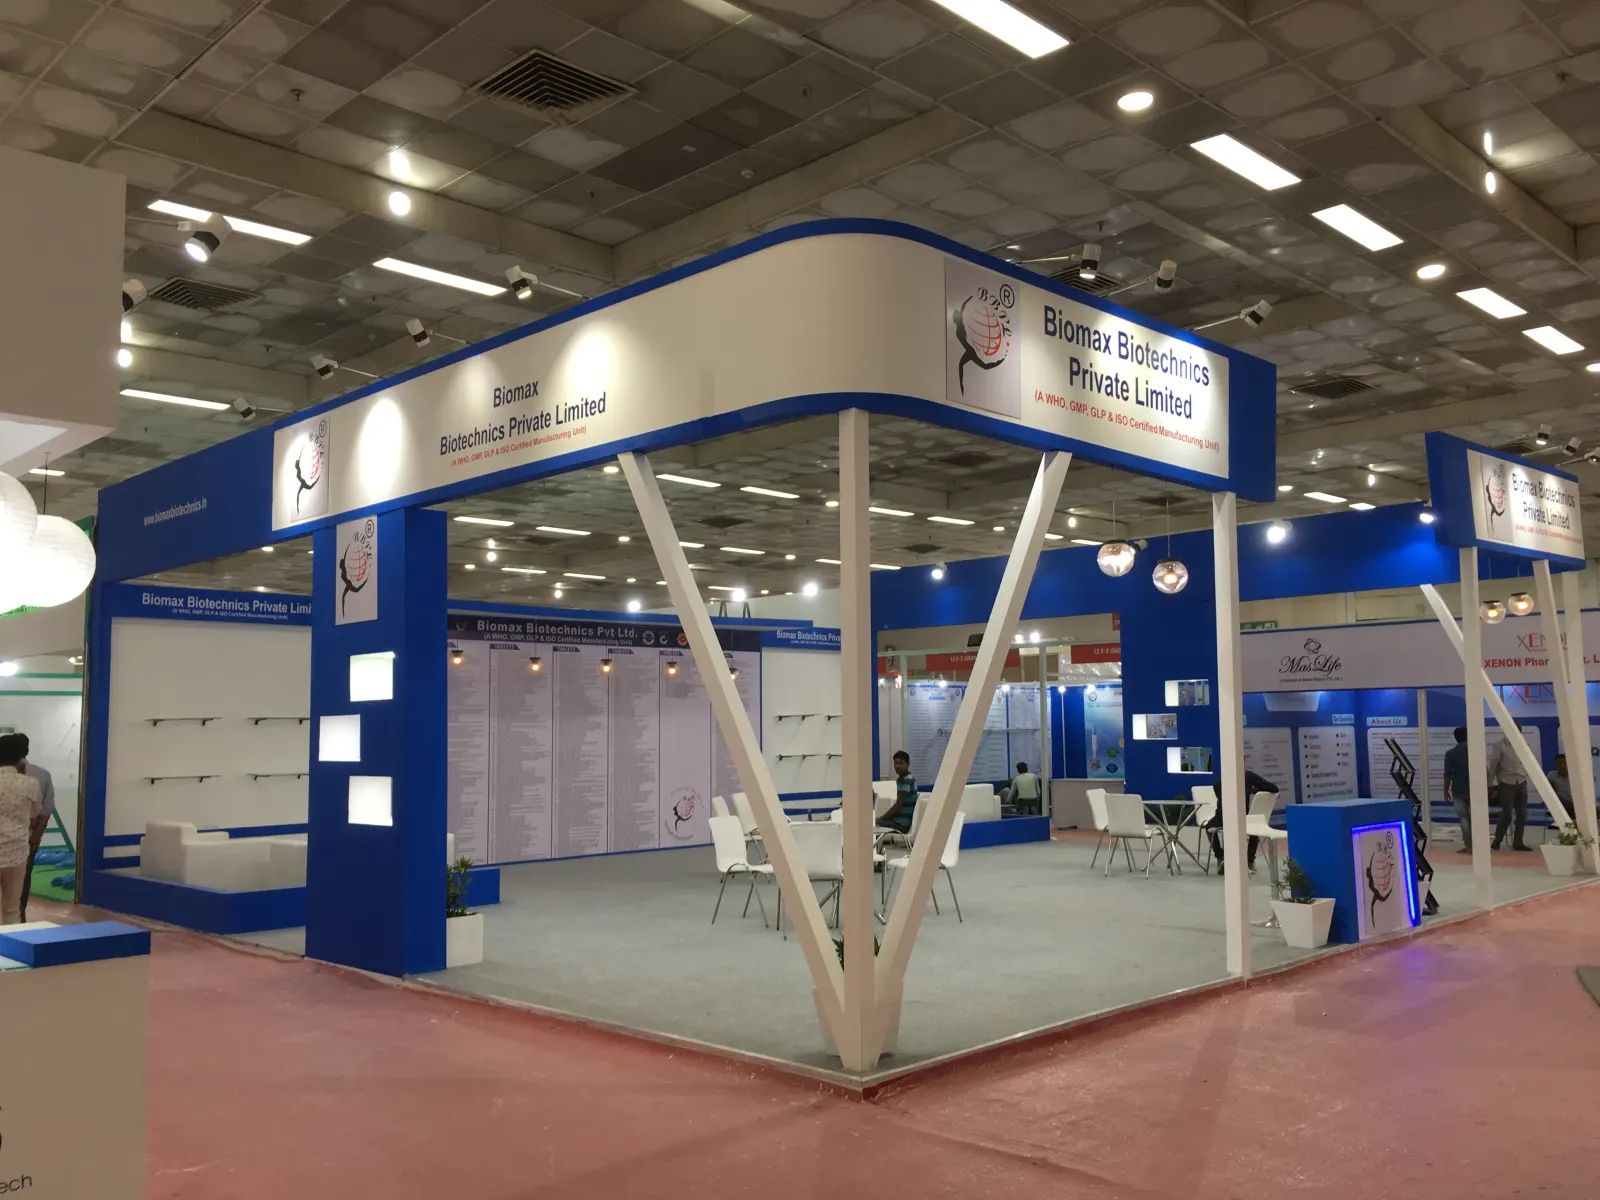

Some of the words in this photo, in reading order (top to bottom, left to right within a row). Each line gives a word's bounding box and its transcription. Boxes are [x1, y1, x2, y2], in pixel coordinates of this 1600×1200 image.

[1044, 305, 1112, 355] Biomax
[1118, 331, 1210, 386] Biotechnics
[493, 381, 539, 408] Biomax
[1069, 356, 1129, 401] Private
[1136, 377, 1192, 420] Limited
[440, 423, 505, 456] Biotechnics
[509, 411, 552, 438] Private
[555, 391, 606, 425] Limited
[1045, 393, 1068, 411] WHO,
[1069, 400, 1089, 416] GMP,
[1091, 407, 1106, 419] GLP
[1108, 411, 1114, 422] &
[1115, 413, 1128, 426] ISO
[1130, 418, 1158, 434] Certified
[1159, 426, 1203, 449] Manufacturing
[1205, 439, 1220, 453] Unit)
[511, 440, 533, 452] Certified
[533, 430, 572, 446] Manufacturing
[1512, 472, 1537, 497] Biomax
[1538, 480, 1576, 508] Biotechnics
[1523, 501, 1546, 524] Private
[1547, 507, 1570, 530] Limited
[142, 592, 184, 608] Biomax
[187, 596, 250, 611] Biotechnics
[253, 600, 288, 614] Private
[290, 603, 312, 615] Limi
[477, 619, 523, 634] Biomax
[527, 620, 594, 636] Biotechnics
[597, 626, 615, 638] Pvt
[618, 628, 639, 639] Ltd.
[557, 635, 581, 643] Certified
[777, 630, 796, 639] Biomax
[798, 631, 827, 641] Biotechnics
[1484, 658, 1521, 668] XENON
[1525, 657, 1549, 667] Phar
